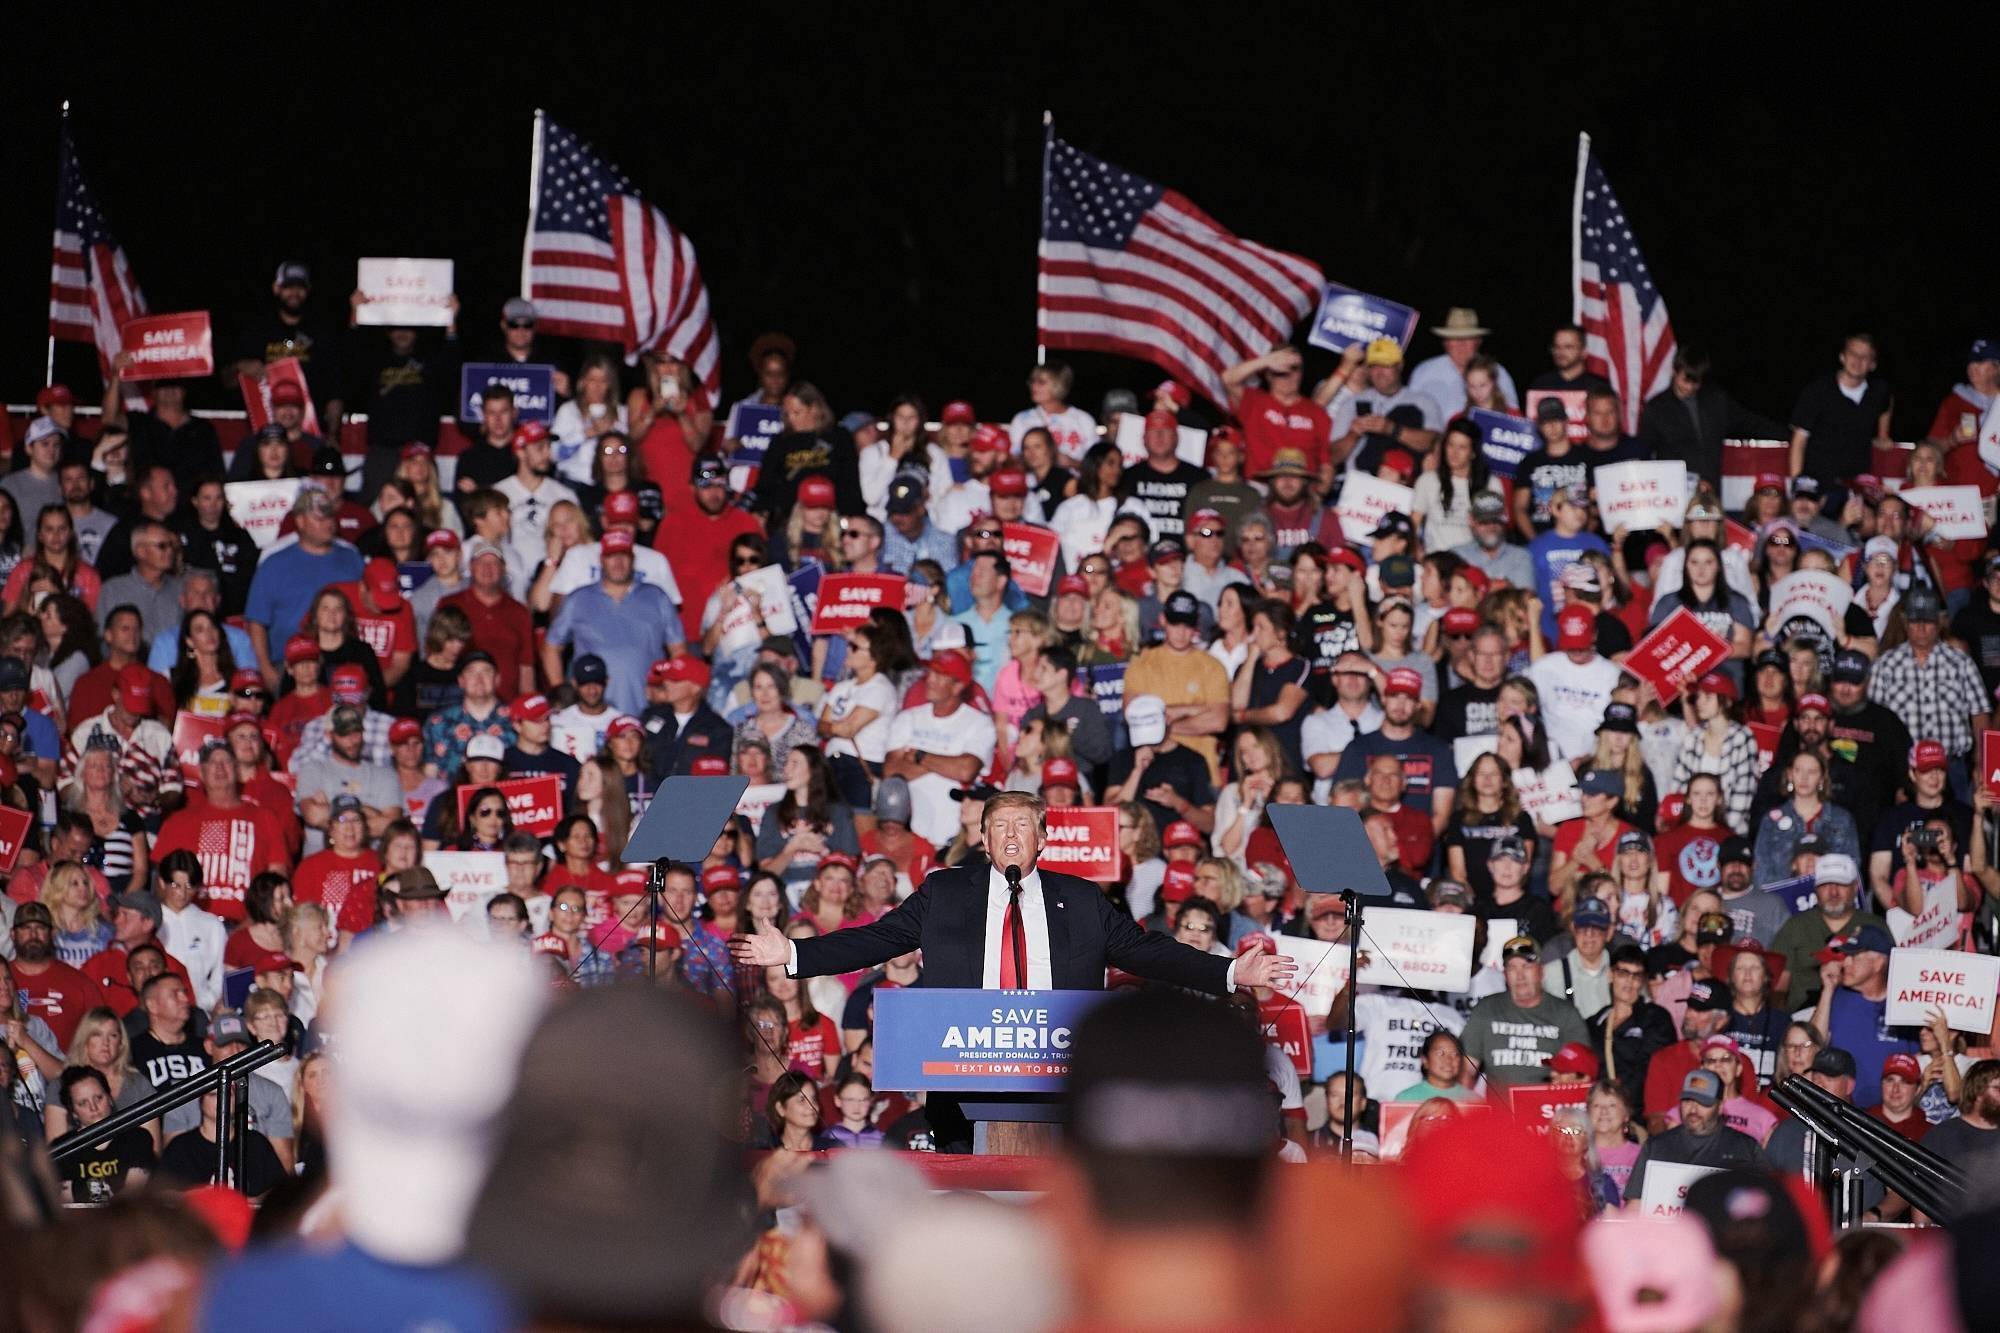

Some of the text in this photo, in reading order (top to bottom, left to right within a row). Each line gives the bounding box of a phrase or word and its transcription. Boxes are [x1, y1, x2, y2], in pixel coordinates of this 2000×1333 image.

[143, 328, 185, 346] SAVE
[757, 419, 784, 434] SA
[1491, 427, 1535, 450] SAVE
[1619, 480, 1657, 493] SAVE
[839, 587, 882, 603] SAVE
[508, 793, 534, 809] VE
[1046, 825, 1089, 842] SAVE
[1038, 847, 1111, 862] MERICA!
[449, 871, 494, 884] SAVE
[1911, 903, 1942, 930] SAVE
[1918, 968, 1967, 986] SAVE
[1897, 989, 1985, 1011] AMERICA!
[988, 1007, 1048, 1024] SAVE
[940, 1024, 1073, 1049] AMERIC
[1490, 1021, 1560, 1039] VETERANS
[1508, 1034, 1538, 1050] FOR
[958, 1051, 1004, 1060] PRESIDENT
[1006, 1051, 1040, 1060] DONALD
[1042, 1052, 1049, 1060] J.
[1387, 1045, 1421, 1060] TRU
[146, 1053, 207, 1088] USA
[954, 1064, 1069, 1074] TEXT IOWA TO 880
[79, 1158, 118, 1178] I GOT
